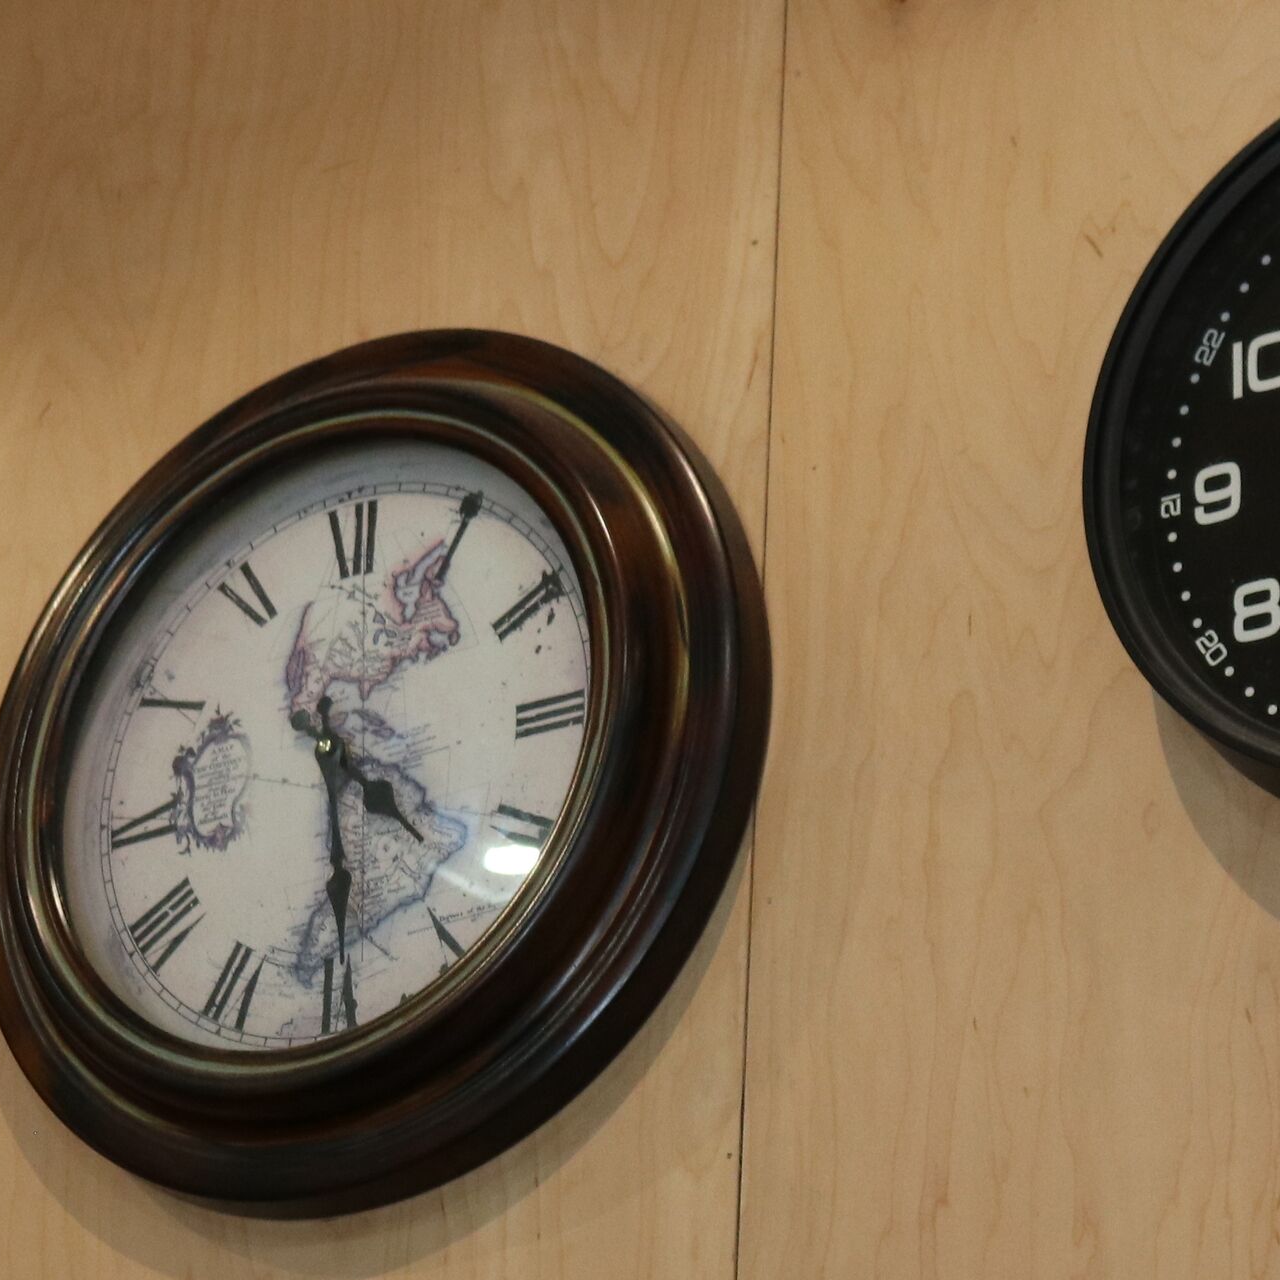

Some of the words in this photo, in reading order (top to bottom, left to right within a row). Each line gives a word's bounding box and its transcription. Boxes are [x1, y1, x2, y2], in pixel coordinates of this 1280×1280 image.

[1193, 328, 1226, 367] 22
[1160, 493, 1182, 519] 21
[1193, 461, 1242, 525] 9
[1195, 629, 1228, 666] 20
